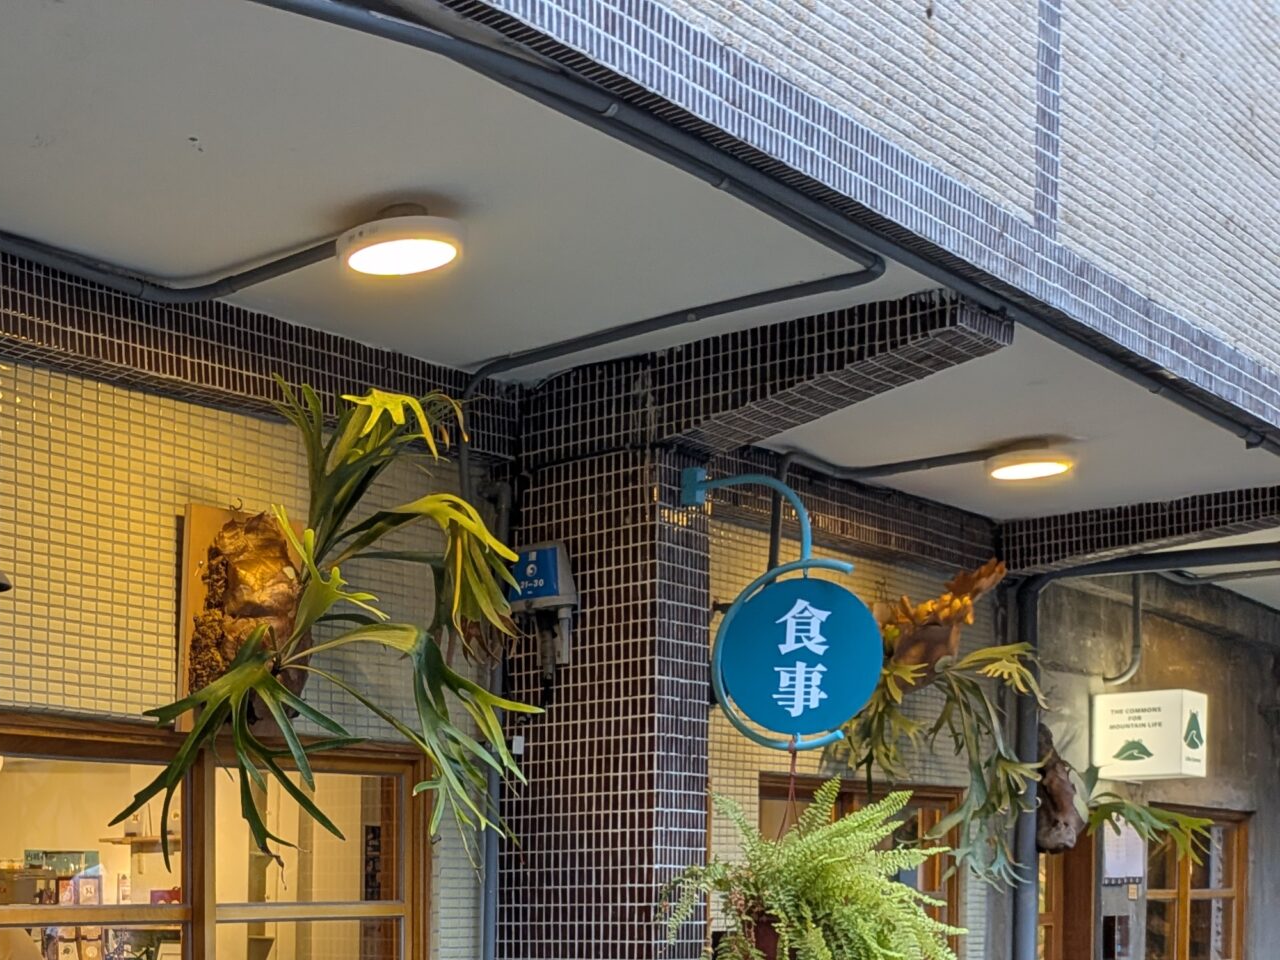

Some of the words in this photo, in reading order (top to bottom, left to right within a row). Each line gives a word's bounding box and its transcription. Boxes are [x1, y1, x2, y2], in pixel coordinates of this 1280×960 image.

[772, 598, 832, 718] 食事
[1125, 706, 1162, 714] COMMONS
[1109, 722, 1147, 730] MOUNTAIN
